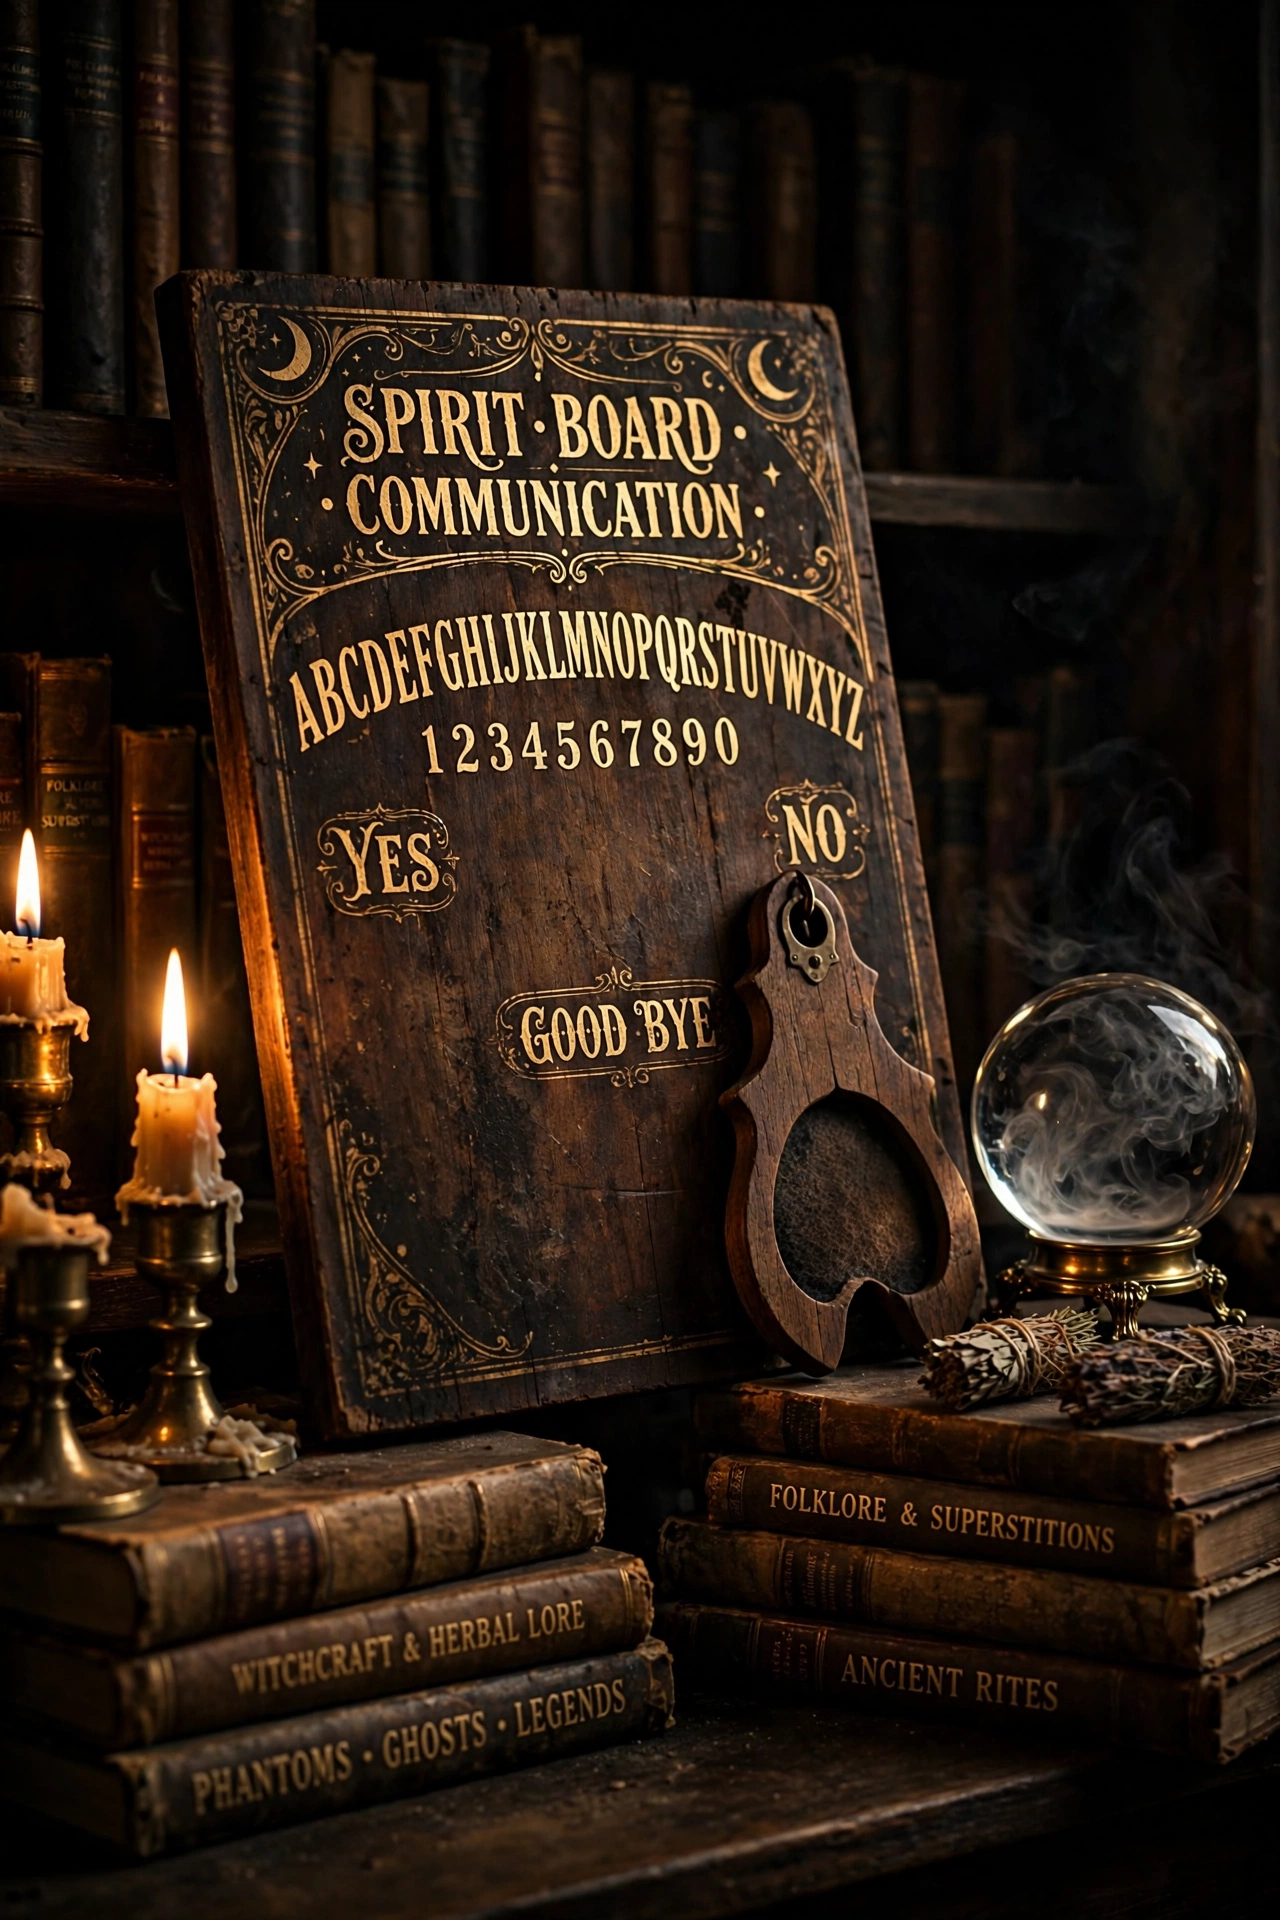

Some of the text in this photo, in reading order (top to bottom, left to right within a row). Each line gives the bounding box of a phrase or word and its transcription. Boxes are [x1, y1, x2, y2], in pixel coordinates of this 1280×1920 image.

[340, 383, 722, 476] SPIRIT BOARD
[345, 473, 745, 539] COMMUNICATION
[782, 801, 848, 866] NO
[520, 996, 717, 1065] GOOD BYE
[769, 1483, 1116, 1555] FOLKLORE & SUPERSTITIONS
[231, 1599, 586, 1695] WITCHCRAFT & HERBAL LORE
[840, 1653, 964, 1698] ANCIENT
[975, 1670, 1060, 1712] RITES
[191, 1679, 628, 1816] PHANTOMS GHOSTS LEGENDS
